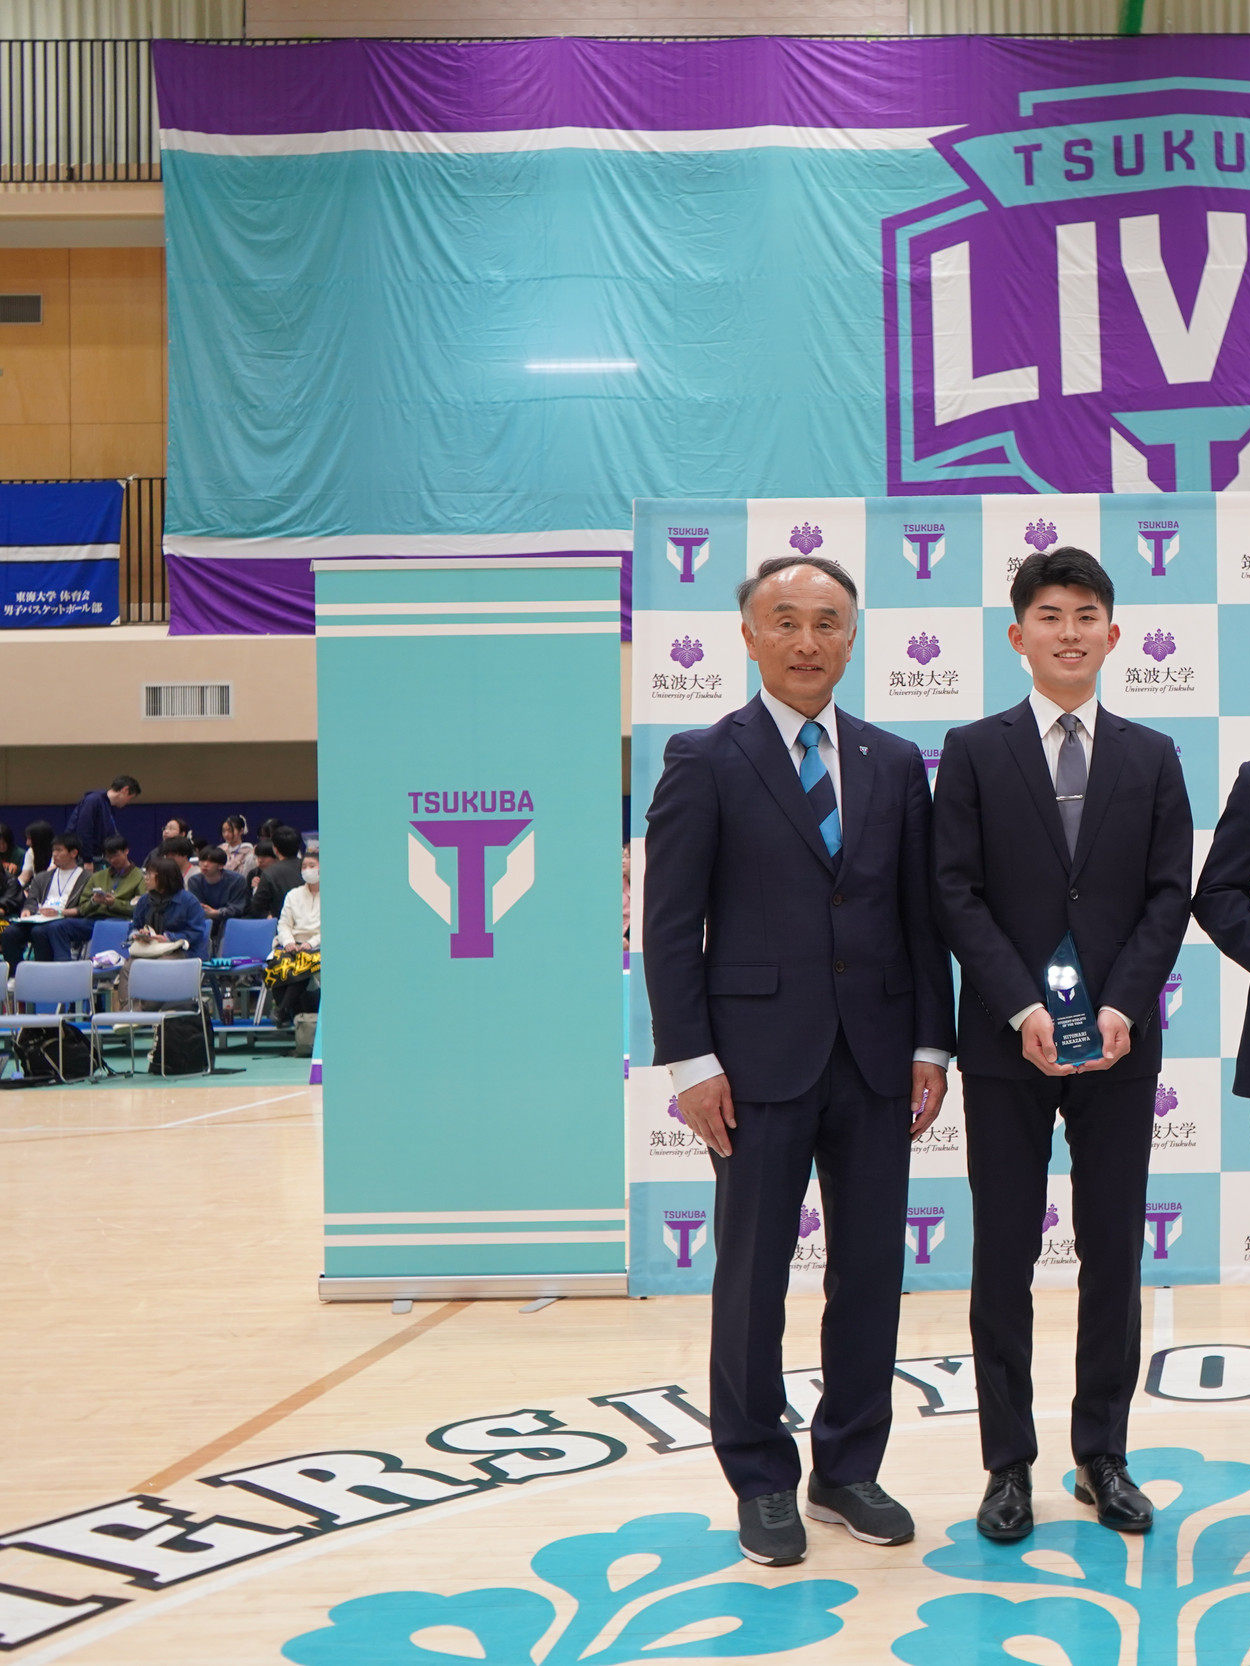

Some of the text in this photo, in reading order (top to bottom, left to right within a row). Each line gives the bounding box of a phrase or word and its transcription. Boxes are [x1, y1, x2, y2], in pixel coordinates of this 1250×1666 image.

[904, 523, 945, 532] TSUKUBA
[1138, 520, 1180, 529] TSUKUBA
[667, 527, 710, 536] TSUKUBA
[889, 670, 959, 688] 筑波大学
[1125, 667, 1194, 684] 筑波大学
[652, 673, 722, 691] 筑波大学
[888, 687, 959, 698] University of Tsukuba
[1125, 684, 1195, 694] University of Tsukuba
[651, 691, 722, 701] University of Tsukuba
[408, 790, 534, 814] TSUKUBA
[650, 1130, 703, 1147] 筑波大
[1168, 1140, 1196, 1148] Tsukuba
[649, 1148, 684, 1157] University
[907, 1206, 945, 1215] SUKUBA
[1146, 1202, 1182, 1211] SUKUBA
[663, 1210, 706, 1219] TSUKUBA
[1049, 1257, 1077, 1265] Tsukuba
